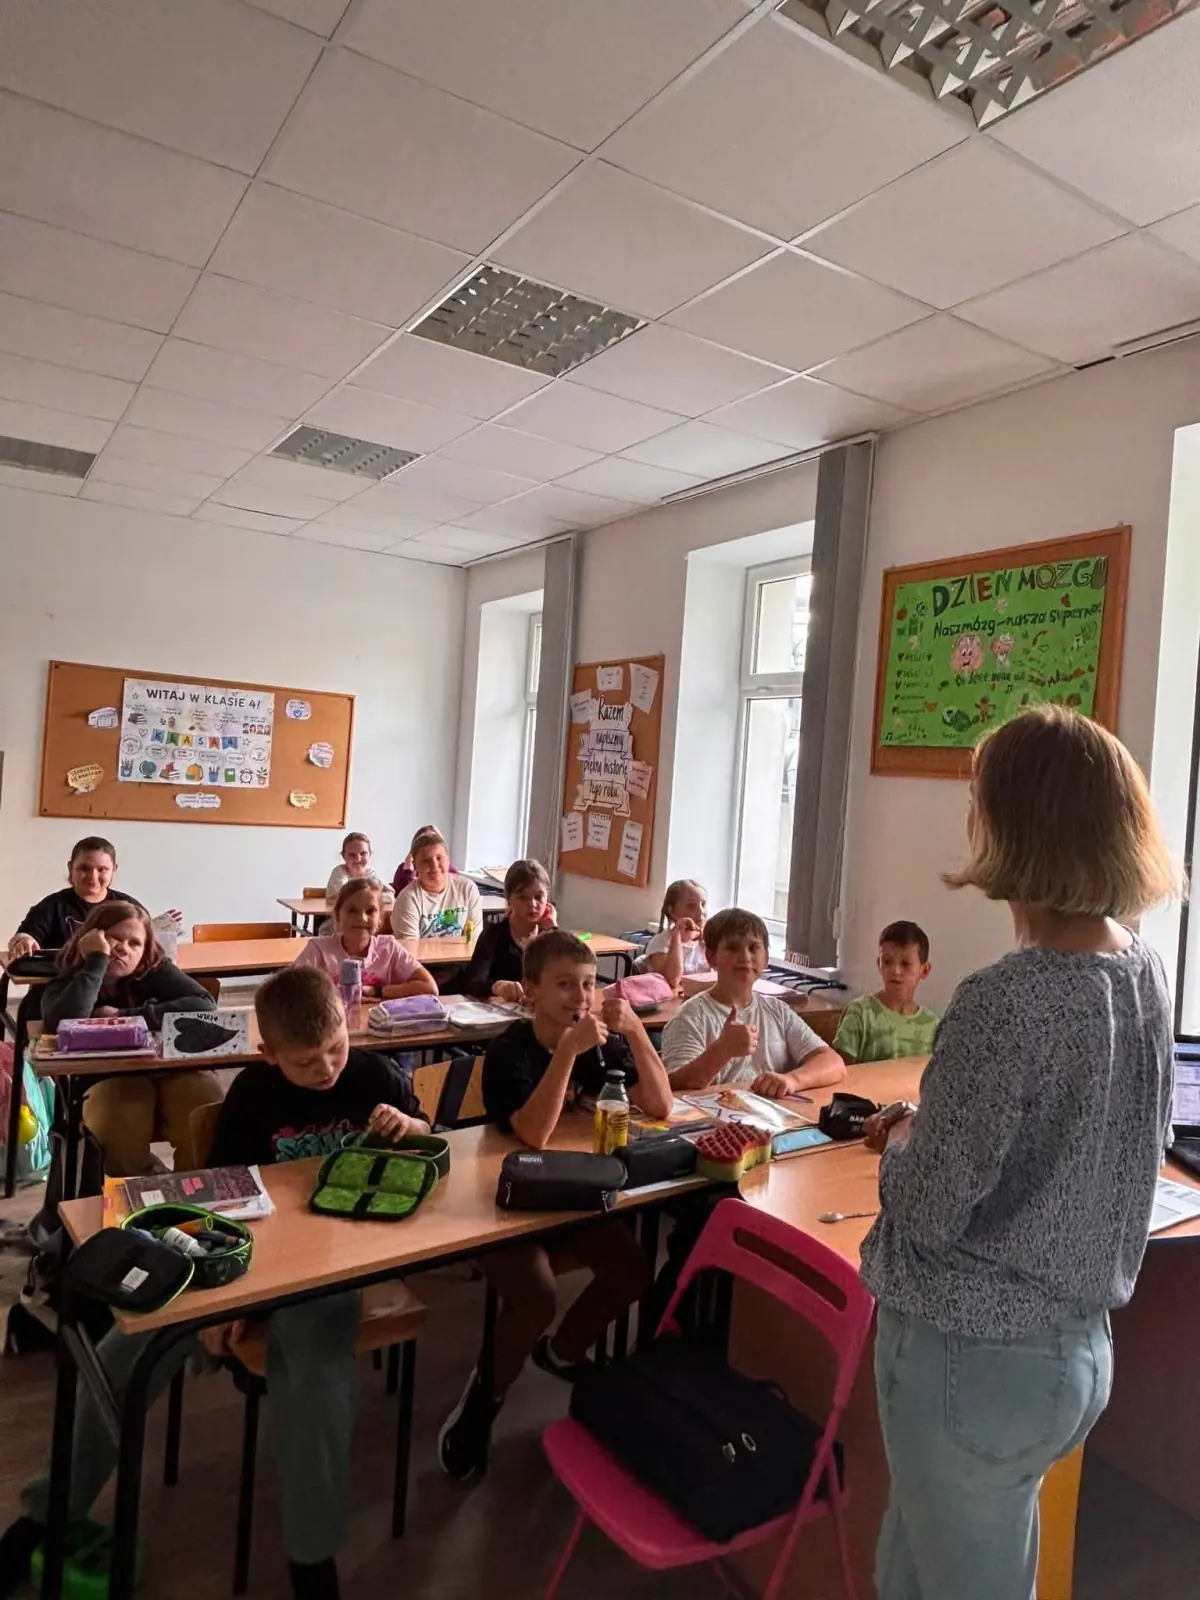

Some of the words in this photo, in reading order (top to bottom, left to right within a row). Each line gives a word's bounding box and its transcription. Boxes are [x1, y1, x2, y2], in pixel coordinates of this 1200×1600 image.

[146, 688, 186, 701] WITAJ
[189, 692, 200, 703] W
[204, 693, 246, 708] KLASIE
[248, 699, 261, 710] 4!
